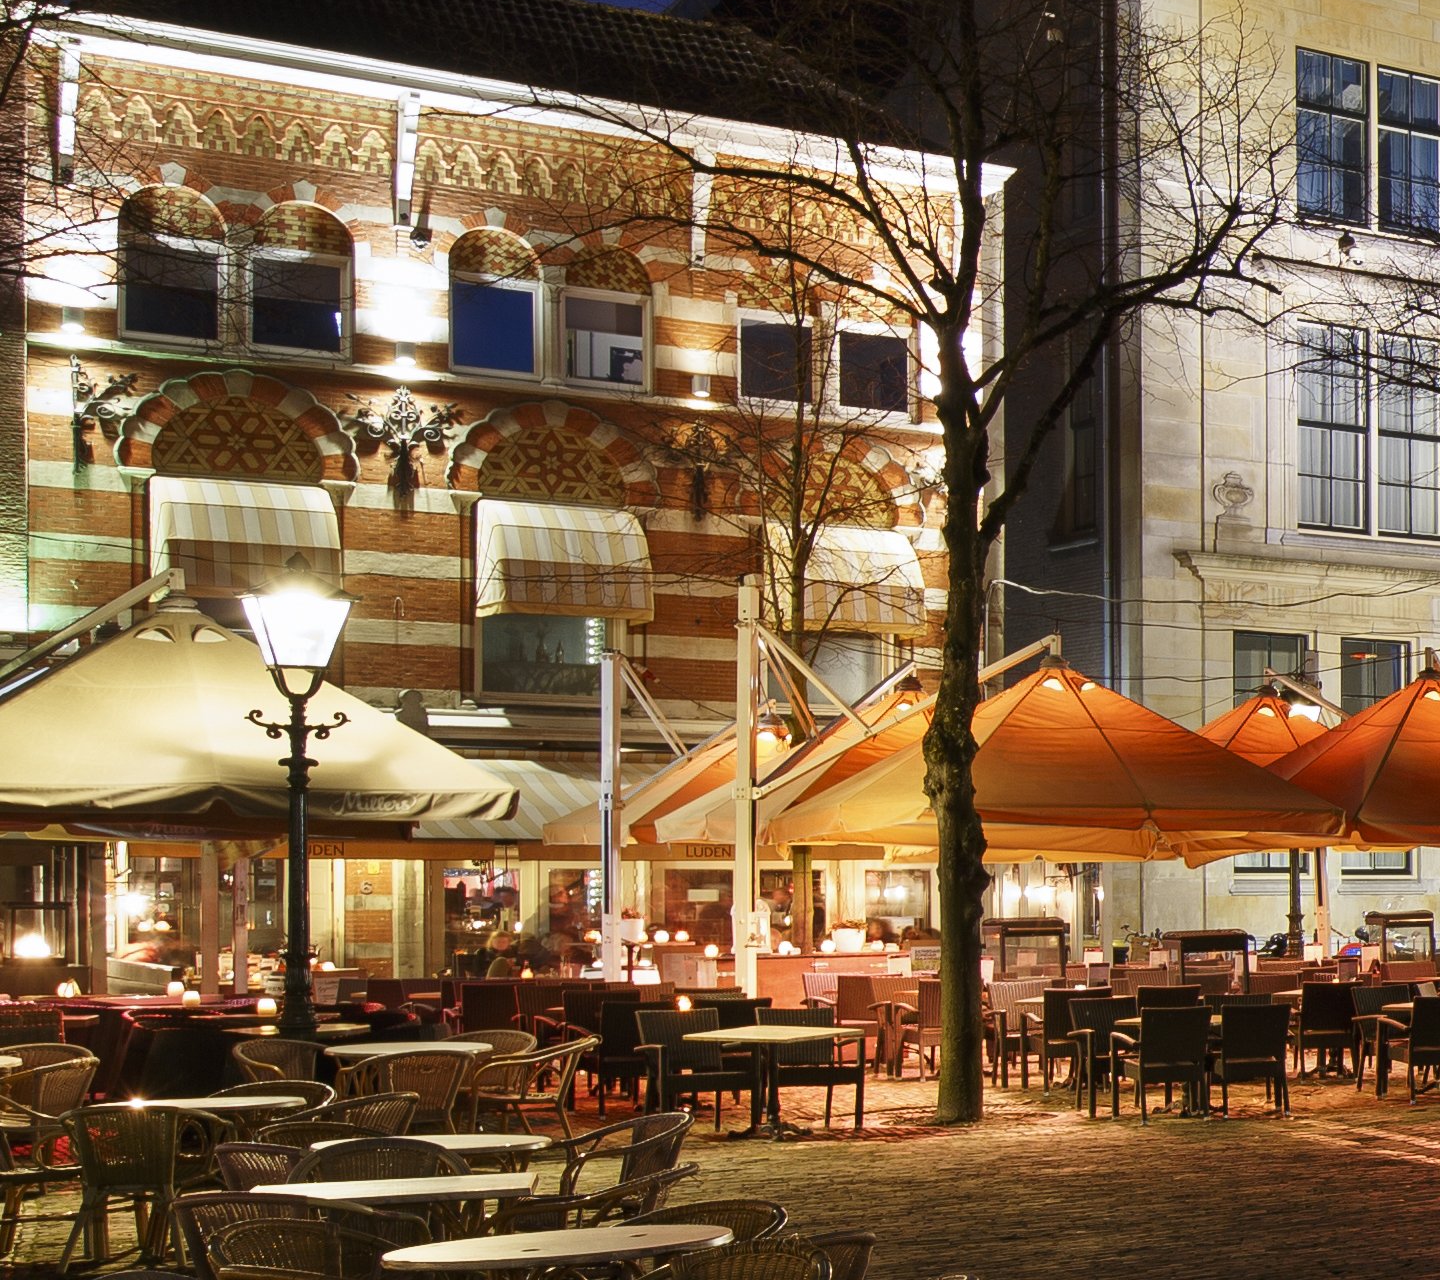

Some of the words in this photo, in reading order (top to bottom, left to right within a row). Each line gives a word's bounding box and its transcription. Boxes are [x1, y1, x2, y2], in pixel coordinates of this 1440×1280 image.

[331, 791, 415, 816] Millers
[308, 842, 345, 857] DEN
[685, 844, 732, 858] LUDEN
[361, 881, 372, 893] 6
